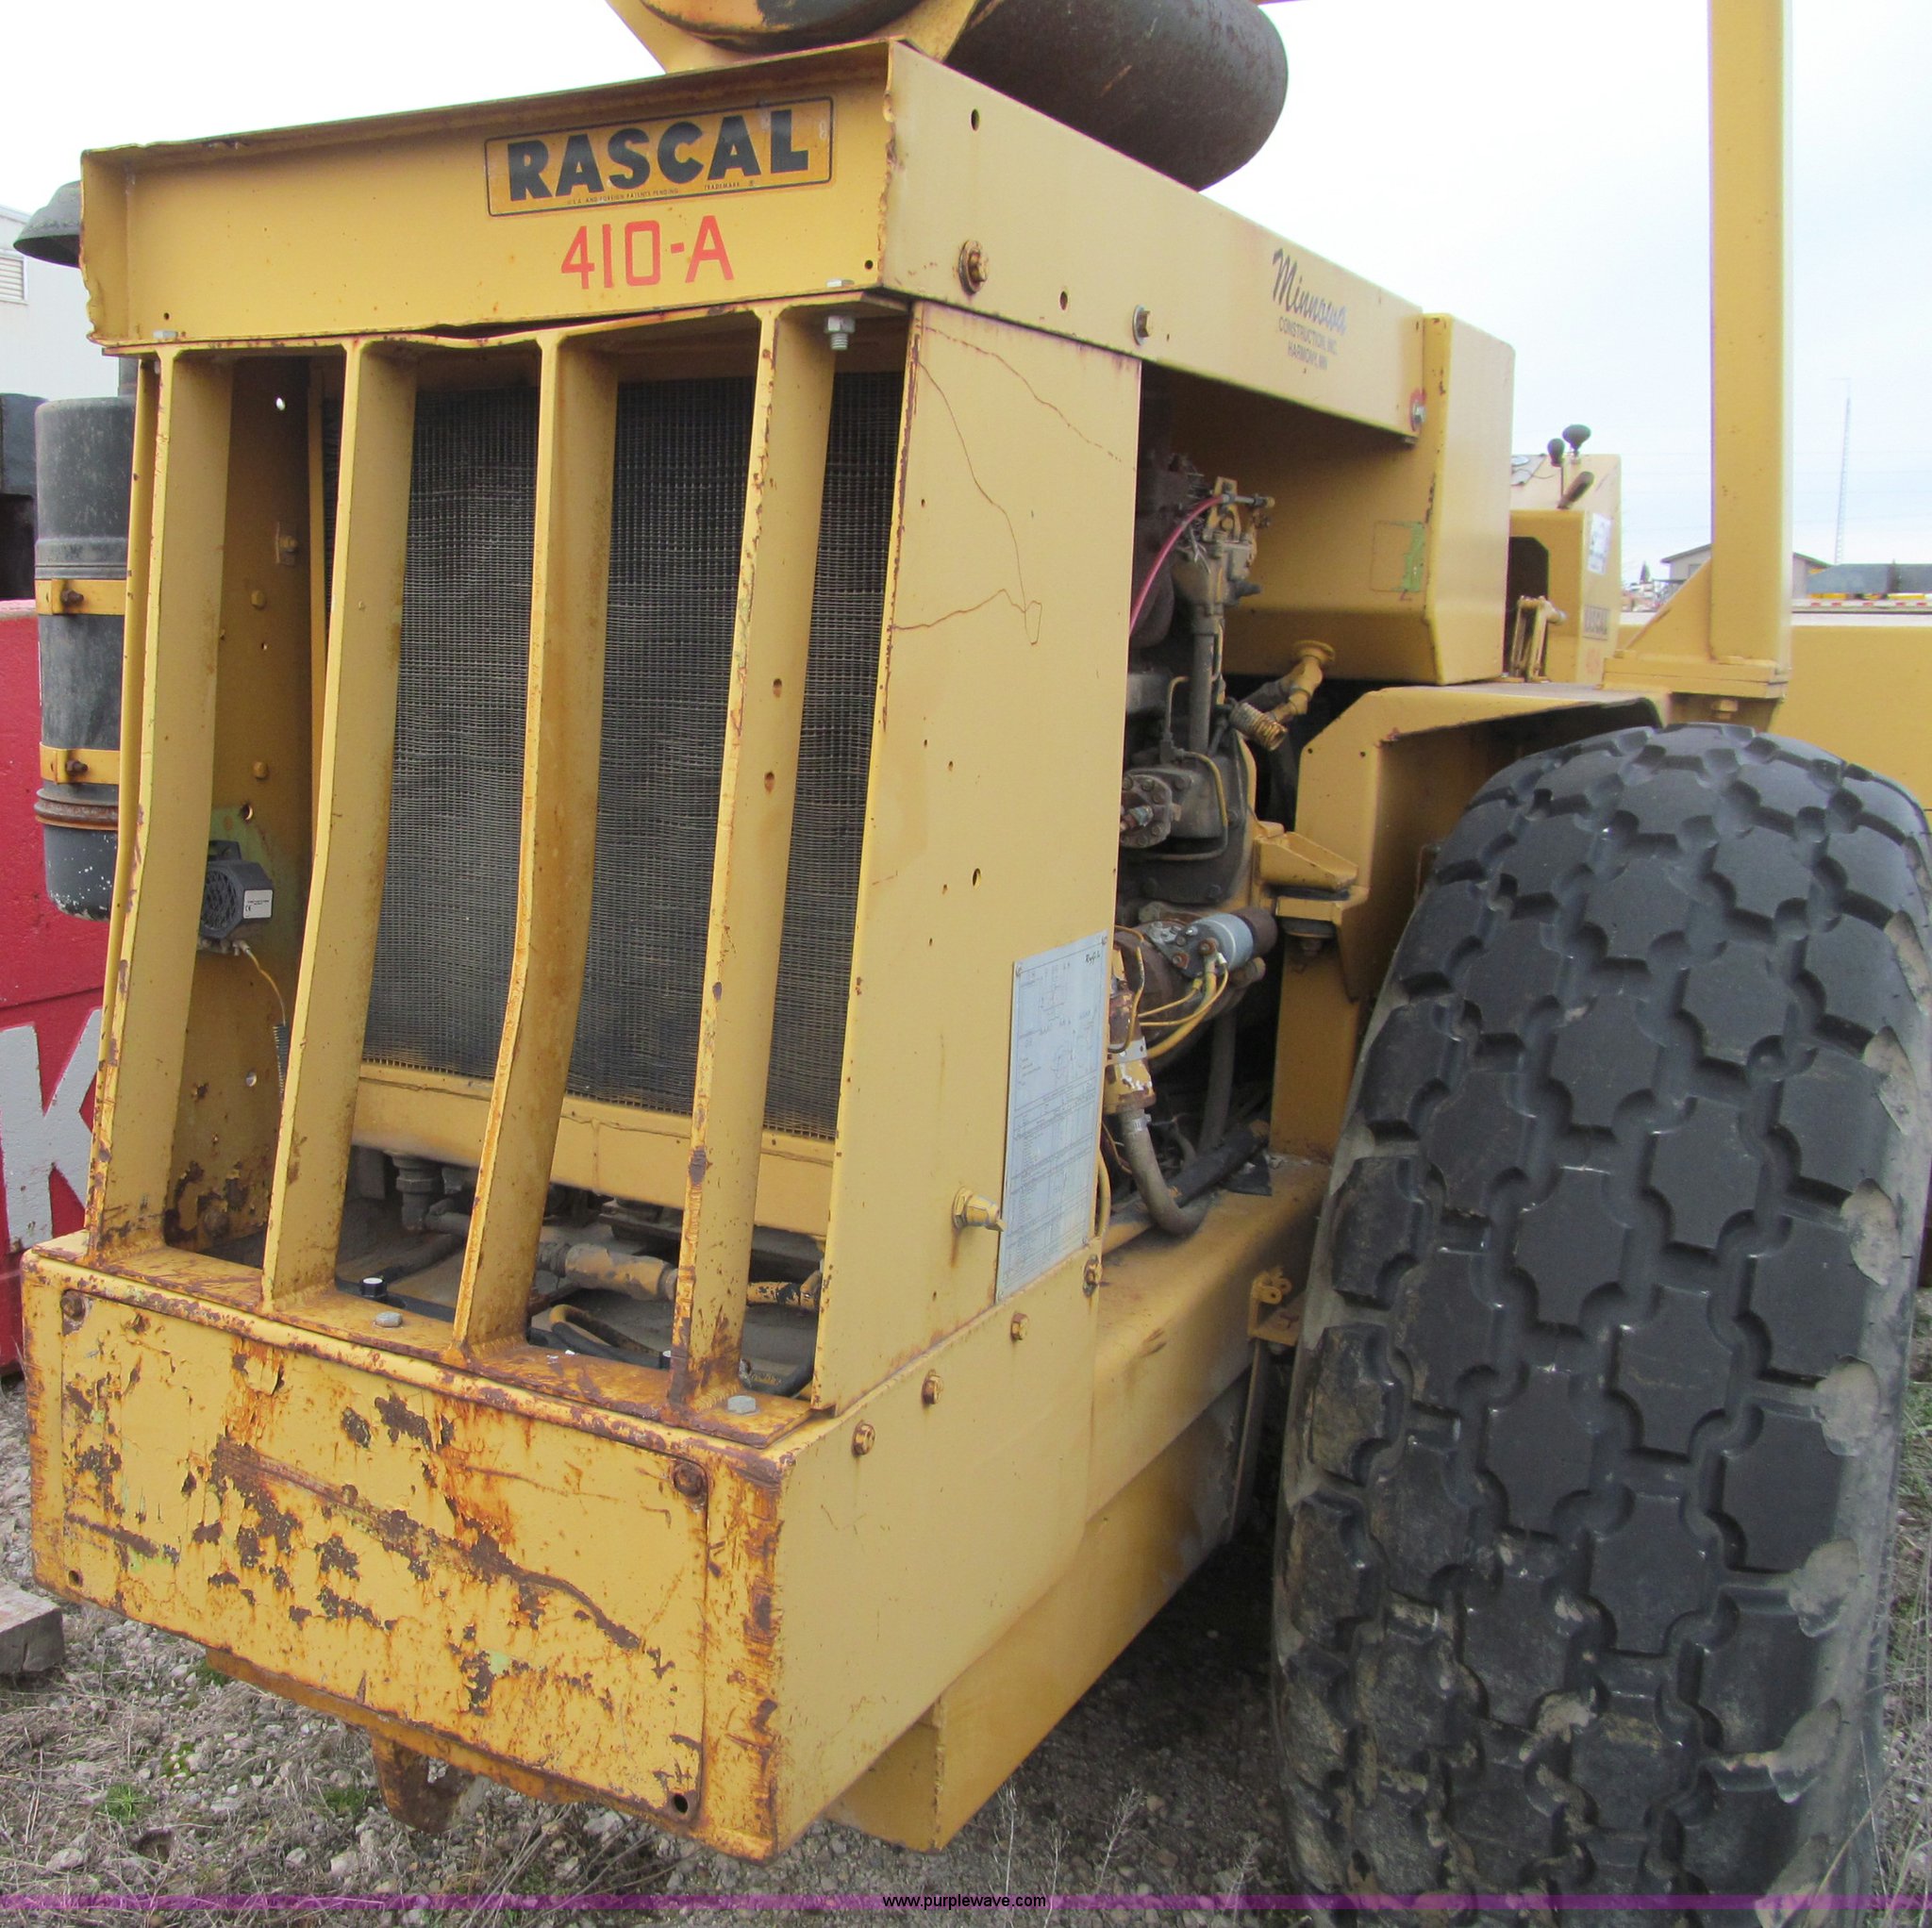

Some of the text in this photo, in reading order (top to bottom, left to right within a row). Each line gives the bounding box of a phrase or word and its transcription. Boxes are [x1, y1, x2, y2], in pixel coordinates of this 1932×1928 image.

[507, 108, 809, 202] RASCAL
[653, 188, 678, 196] PENDING
[704, 181, 740, 191] TRADEMARK
[561, 215, 734, 290] 410-A
